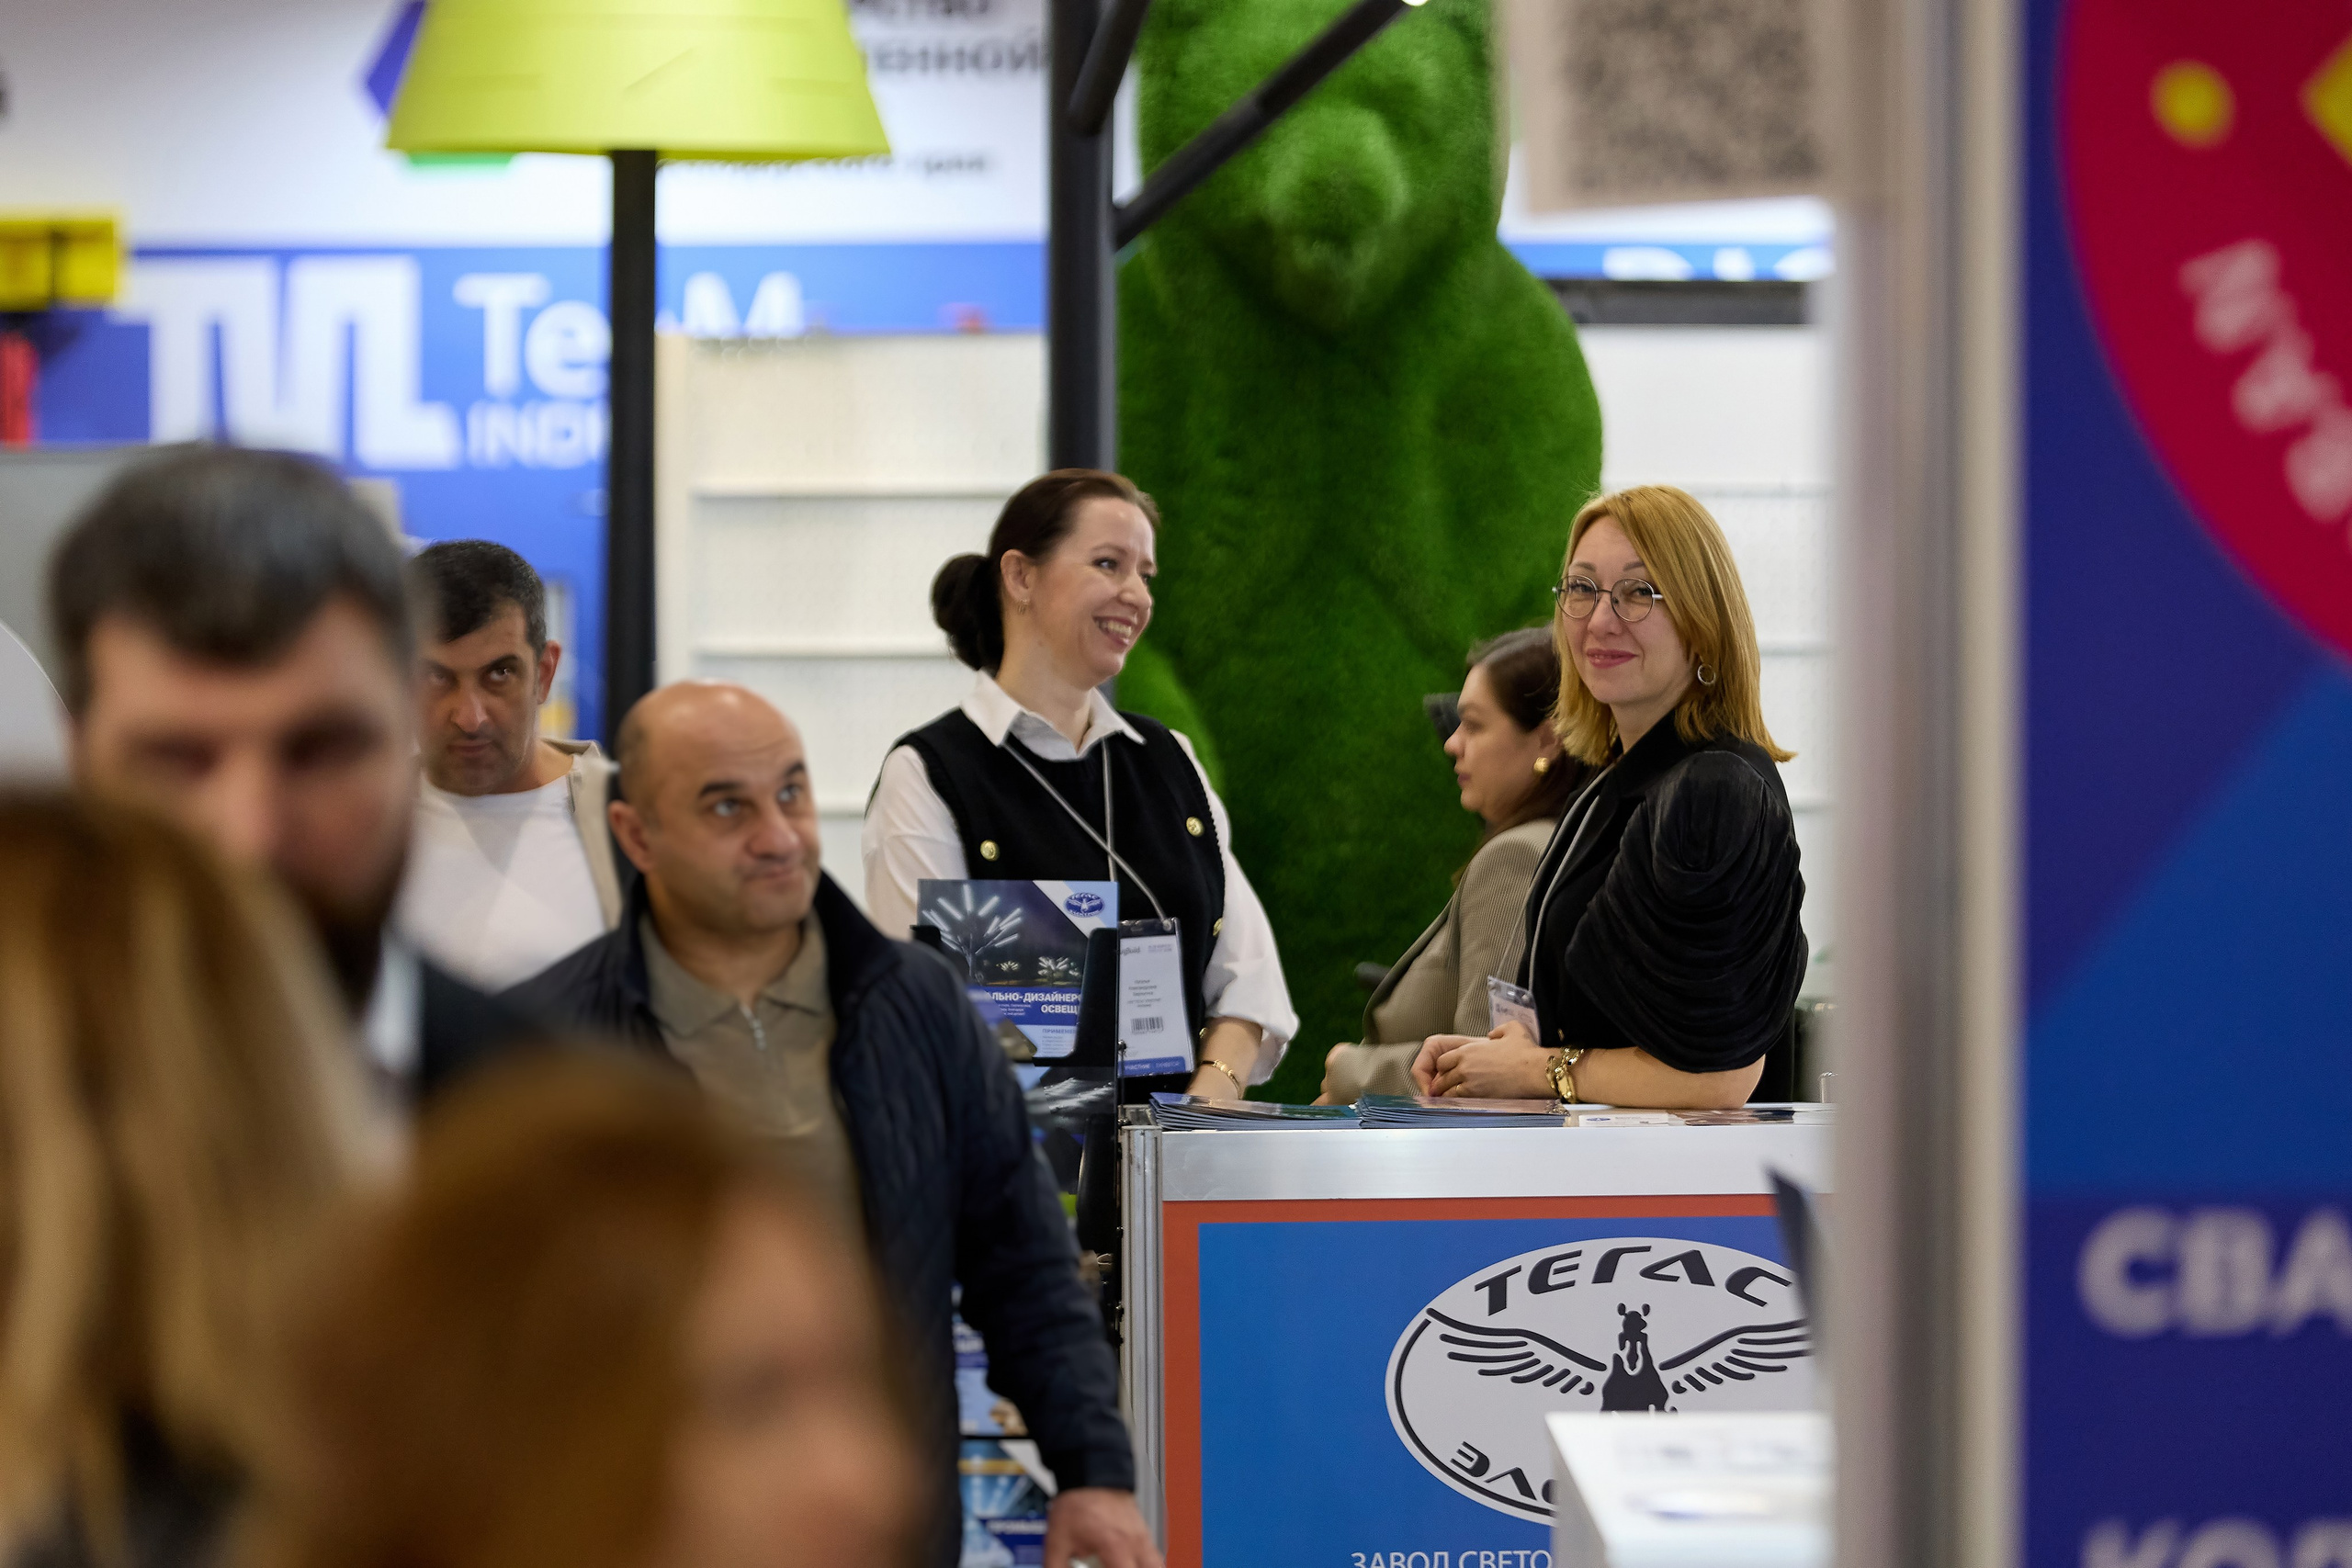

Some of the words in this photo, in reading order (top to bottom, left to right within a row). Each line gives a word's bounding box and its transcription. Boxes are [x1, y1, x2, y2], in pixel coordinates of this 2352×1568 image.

[985, 990, 1082, 1003] ЛЬНО-ДИЗАЙНЕР
[1041, 1004, 1080, 1015] ОСВЕЩ
[1474, 1245, 1793, 1316] ТЕГАС
